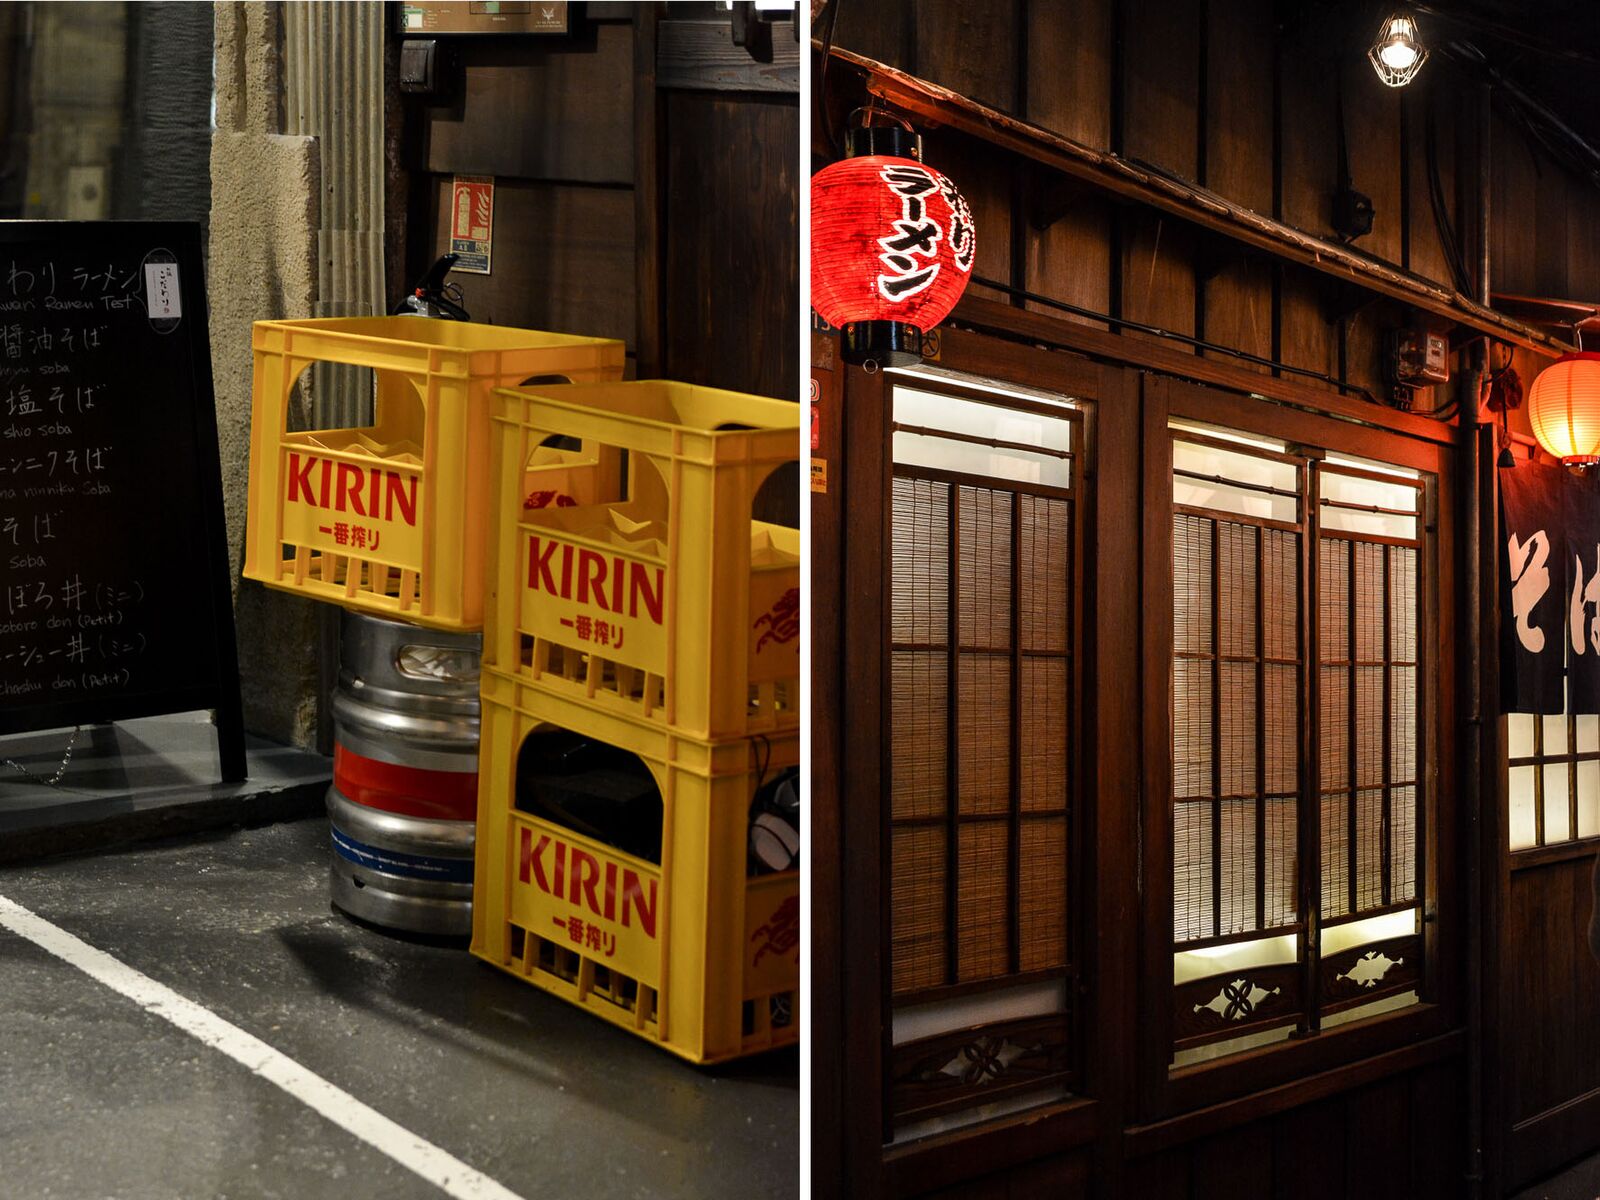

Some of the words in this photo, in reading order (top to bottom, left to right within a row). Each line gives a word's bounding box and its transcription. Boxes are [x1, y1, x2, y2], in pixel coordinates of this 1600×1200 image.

[877, 165, 943, 302] ラーメン
[100, 295, 134, 311] Test
[5, 384, 107, 416] 塩そば
[3, 424, 32, 438] shio
[37, 421, 72, 437] soba
[287, 453, 418, 527] KIRIN
[319, 522, 380, 551] 一番搾り
[527, 535, 665, 626] KIRIN
[559, 614, 624, 650] 一番搾り
[519, 826, 658, 939] KIRIN
[552, 916, 616, 957] 一番搾り
